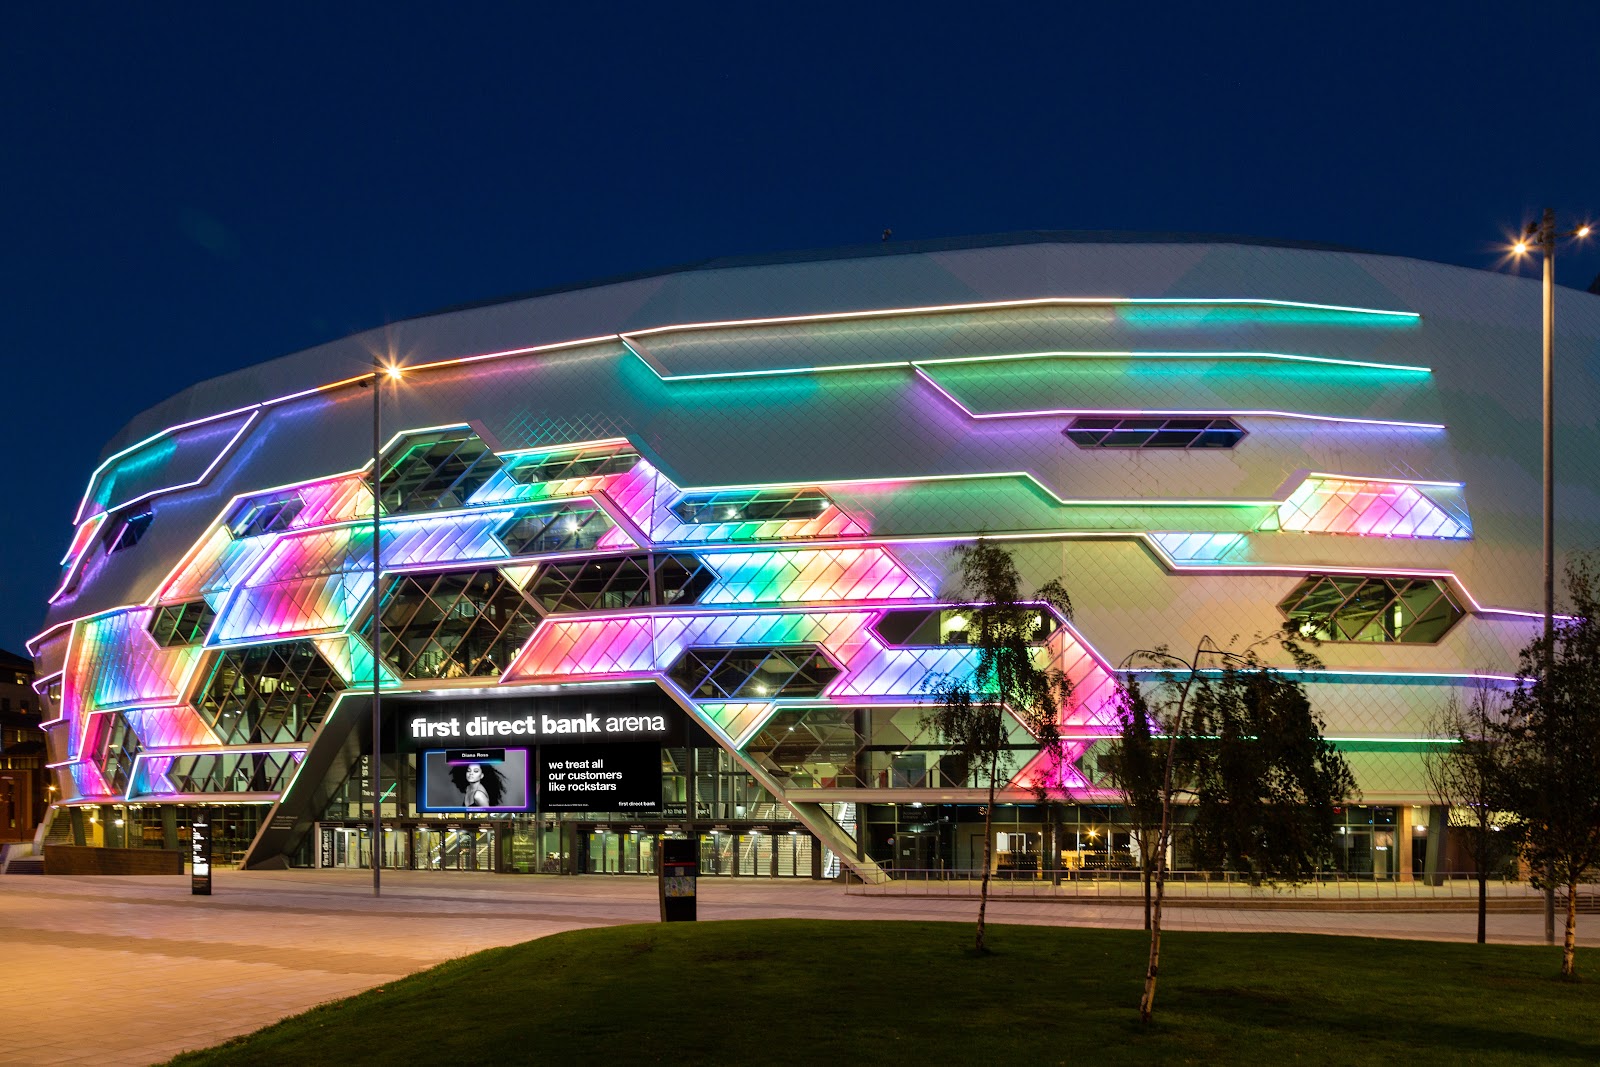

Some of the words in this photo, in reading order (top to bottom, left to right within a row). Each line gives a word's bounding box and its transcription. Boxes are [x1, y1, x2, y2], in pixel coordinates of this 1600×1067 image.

[410, 717, 461, 738] first
[465, 715, 536, 737] direct
[541, 713, 602, 735] bank
[605, 715, 666, 733] arena
[548, 761, 564, 769] we
[565, 759, 590, 769] treat
[591, 758, 604, 769] all
[548, 772, 566, 780] our
[567, 770, 623, 780] customers
[548, 781, 566, 792] like
[567, 781, 617, 792] rockstars
